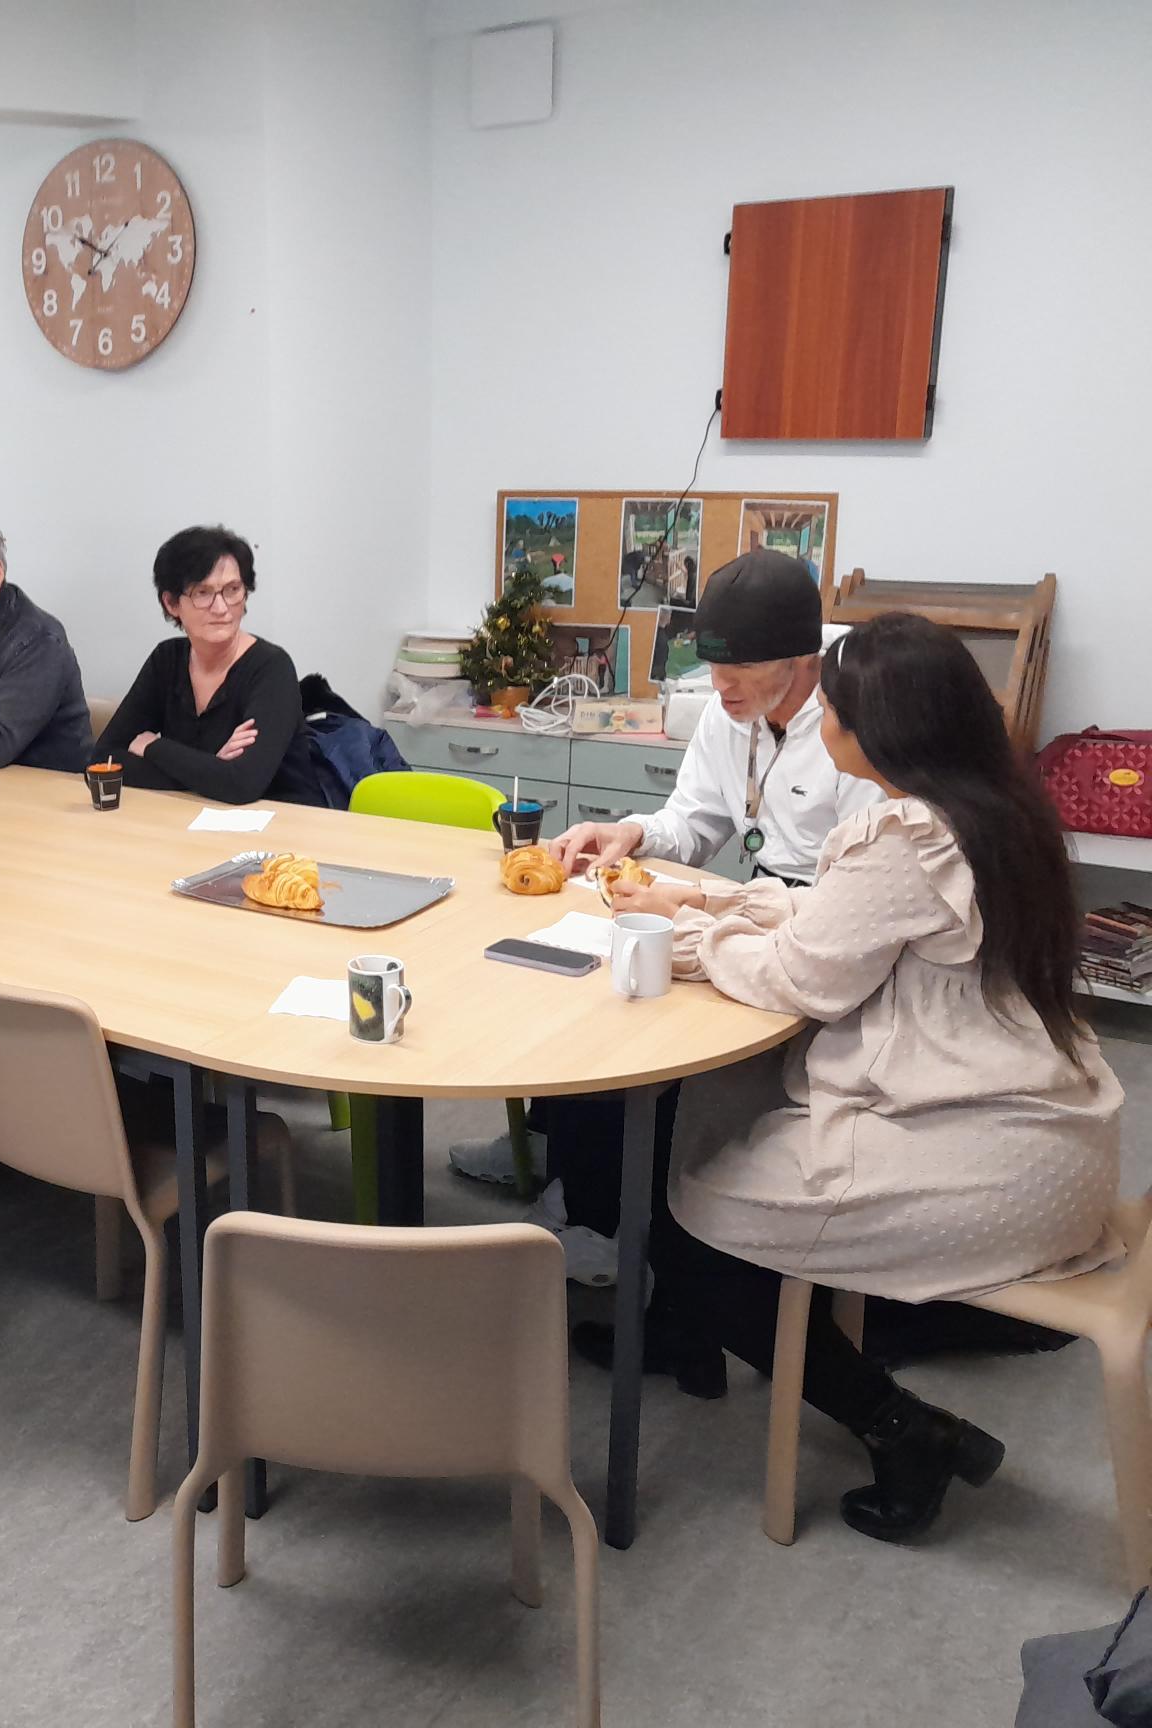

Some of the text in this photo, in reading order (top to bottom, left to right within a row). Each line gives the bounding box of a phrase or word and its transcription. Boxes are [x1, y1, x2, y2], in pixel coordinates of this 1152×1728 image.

[92, 153, 116, 183] 12
[134, 161, 142, 191] 1
[65, 169, 80, 198] 11
[40, 205, 63, 233] 10
[156, 191, 171, 219] 2
[31, 248, 47, 275] 9
[167, 235, 183, 264] 3
[43, 289, 58, 317] 8
[155, 281, 171, 309] 4
[69, 319, 84, 346] 7
[98, 328, 113, 355] 6
[131, 314, 146, 343] 5
